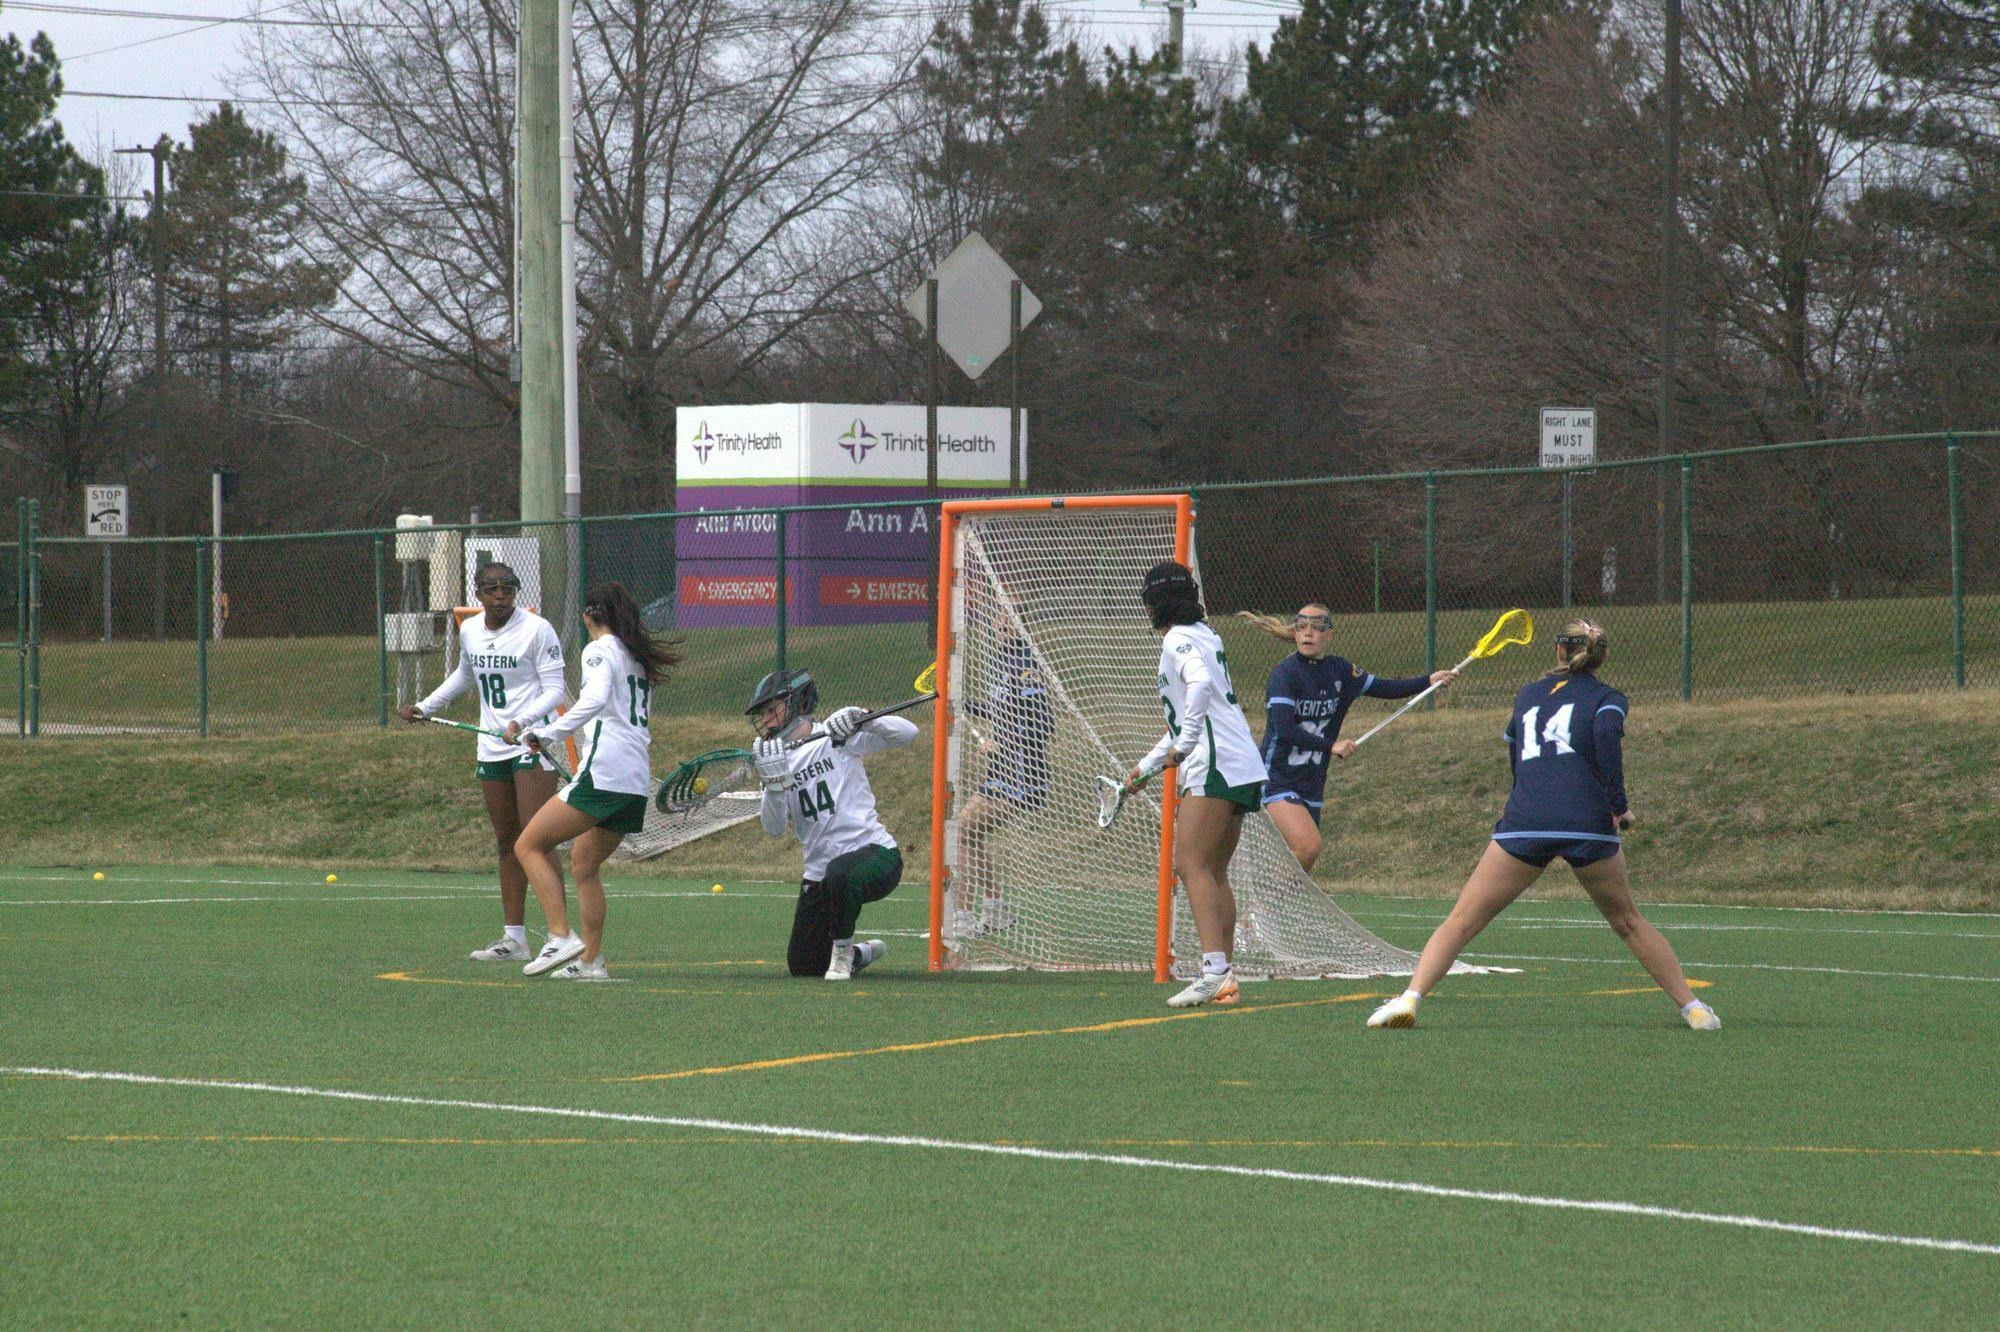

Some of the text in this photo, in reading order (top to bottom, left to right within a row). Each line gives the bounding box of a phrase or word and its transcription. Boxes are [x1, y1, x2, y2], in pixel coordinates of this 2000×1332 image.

[1545, 417, 1592, 428] RIGHT LANE
[715, 431, 782, 455] Trinity Health
[882, 433, 995, 453] Trinit Health
[1554, 435, 1583, 447] MUST
[1544, 454, 1592, 465] TURN RIGHT
[92, 490, 121, 500] STOP
[100, 523, 123, 533] RED
[845, 509, 902, 533] Ann
[479, 673, 506, 709] 18
[1294, 699, 1322, 718] KENT
[1521, 702, 1576, 761] 14
[790, 757, 834, 792] ASTERN
[798, 780, 835, 822] 44
